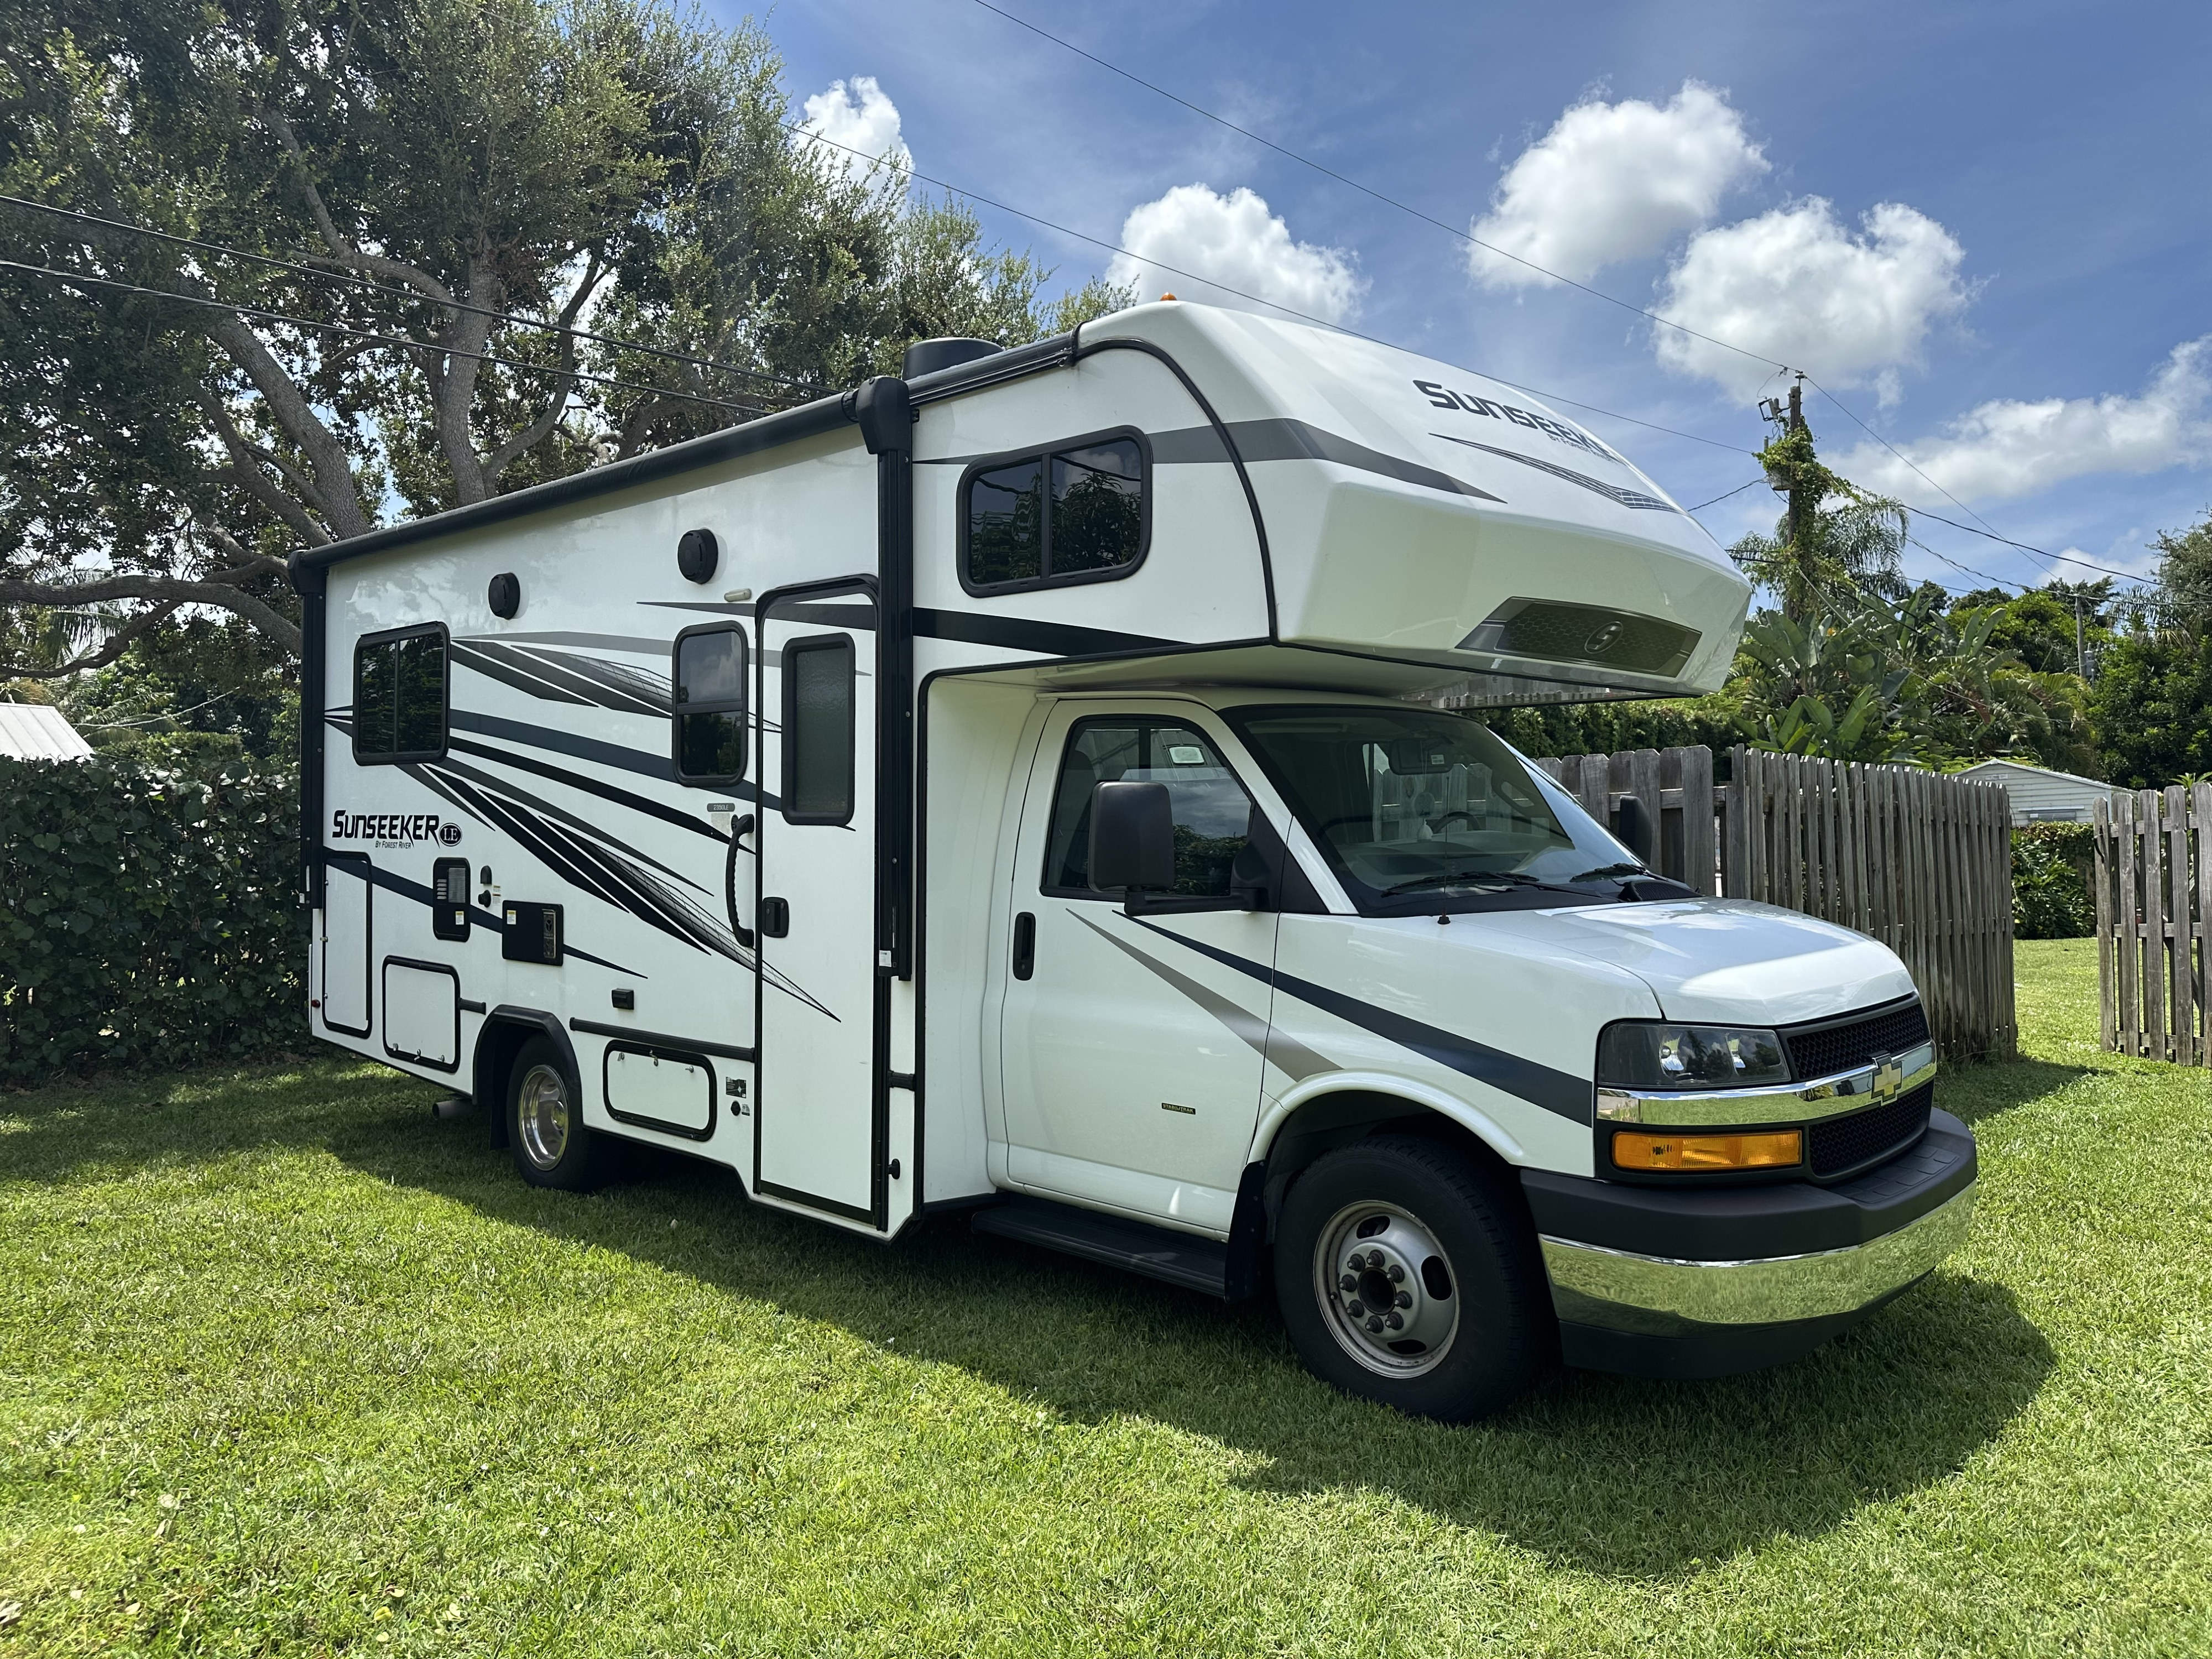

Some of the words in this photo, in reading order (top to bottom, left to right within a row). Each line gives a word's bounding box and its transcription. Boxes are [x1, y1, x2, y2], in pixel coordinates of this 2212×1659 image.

[1412, 380, 1627, 466] SUNSEEKE
[332, 810, 441, 849] SUNSEEKER
[443, 828, 458, 841] LE
